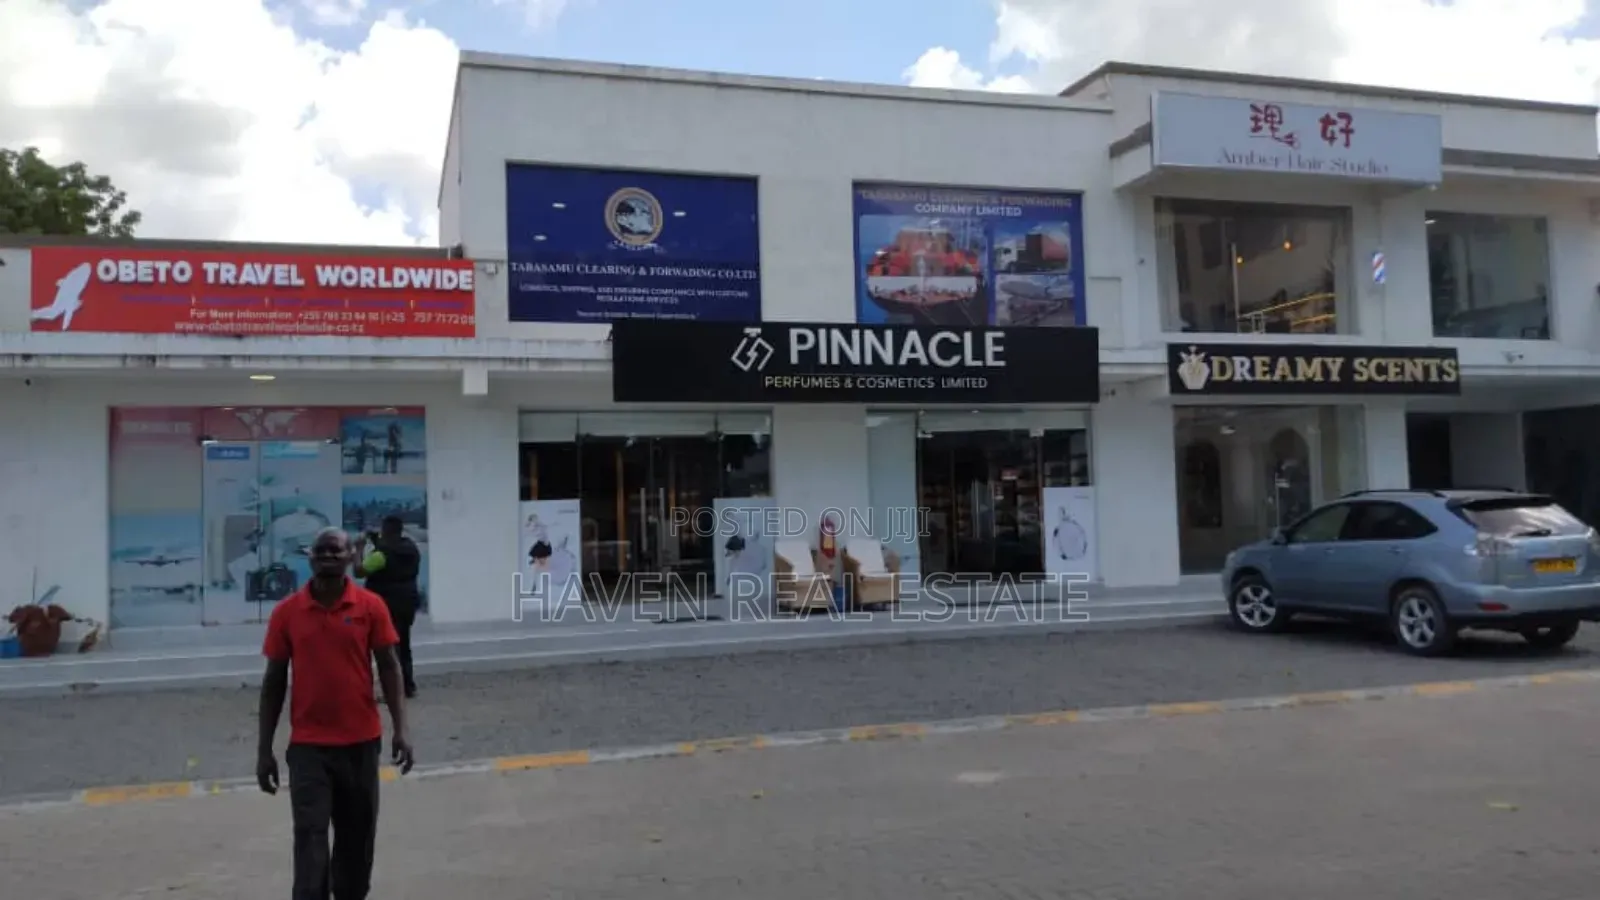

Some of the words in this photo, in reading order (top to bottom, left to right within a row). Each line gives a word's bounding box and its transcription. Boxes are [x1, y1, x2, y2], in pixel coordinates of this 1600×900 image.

[1217, 148, 1280, 167] Amber
[1288, 151, 1323, 171] Hair
[1329, 156, 1390, 175] Studio
[914, 203, 974, 216] COMPANY
[976, 205, 1022, 217] LIMITED
[97, 259, 193, 283] OBETO
[202, 262, 305, 286] TRAVEL
[315, 264, 473, 290] WORLDWIDE
[576, 263, 635, 276] CLEARING
[638, 265, 647, 276] &
[190, 308, 207, 319] For
[209, 308, 235, 319] More
[788, 328, 1007, 367] PINNACLE
[1211, 356, 1345, 382] DREAMY
[1352, 357, 1458, 382] SCENTS
[765, 375, 840, 388] PERFUMES
[843, 376, 853, 388] &
[856, 376, 935, 389] COSMETICS
[941, 376, 988, 389] LIMITED
